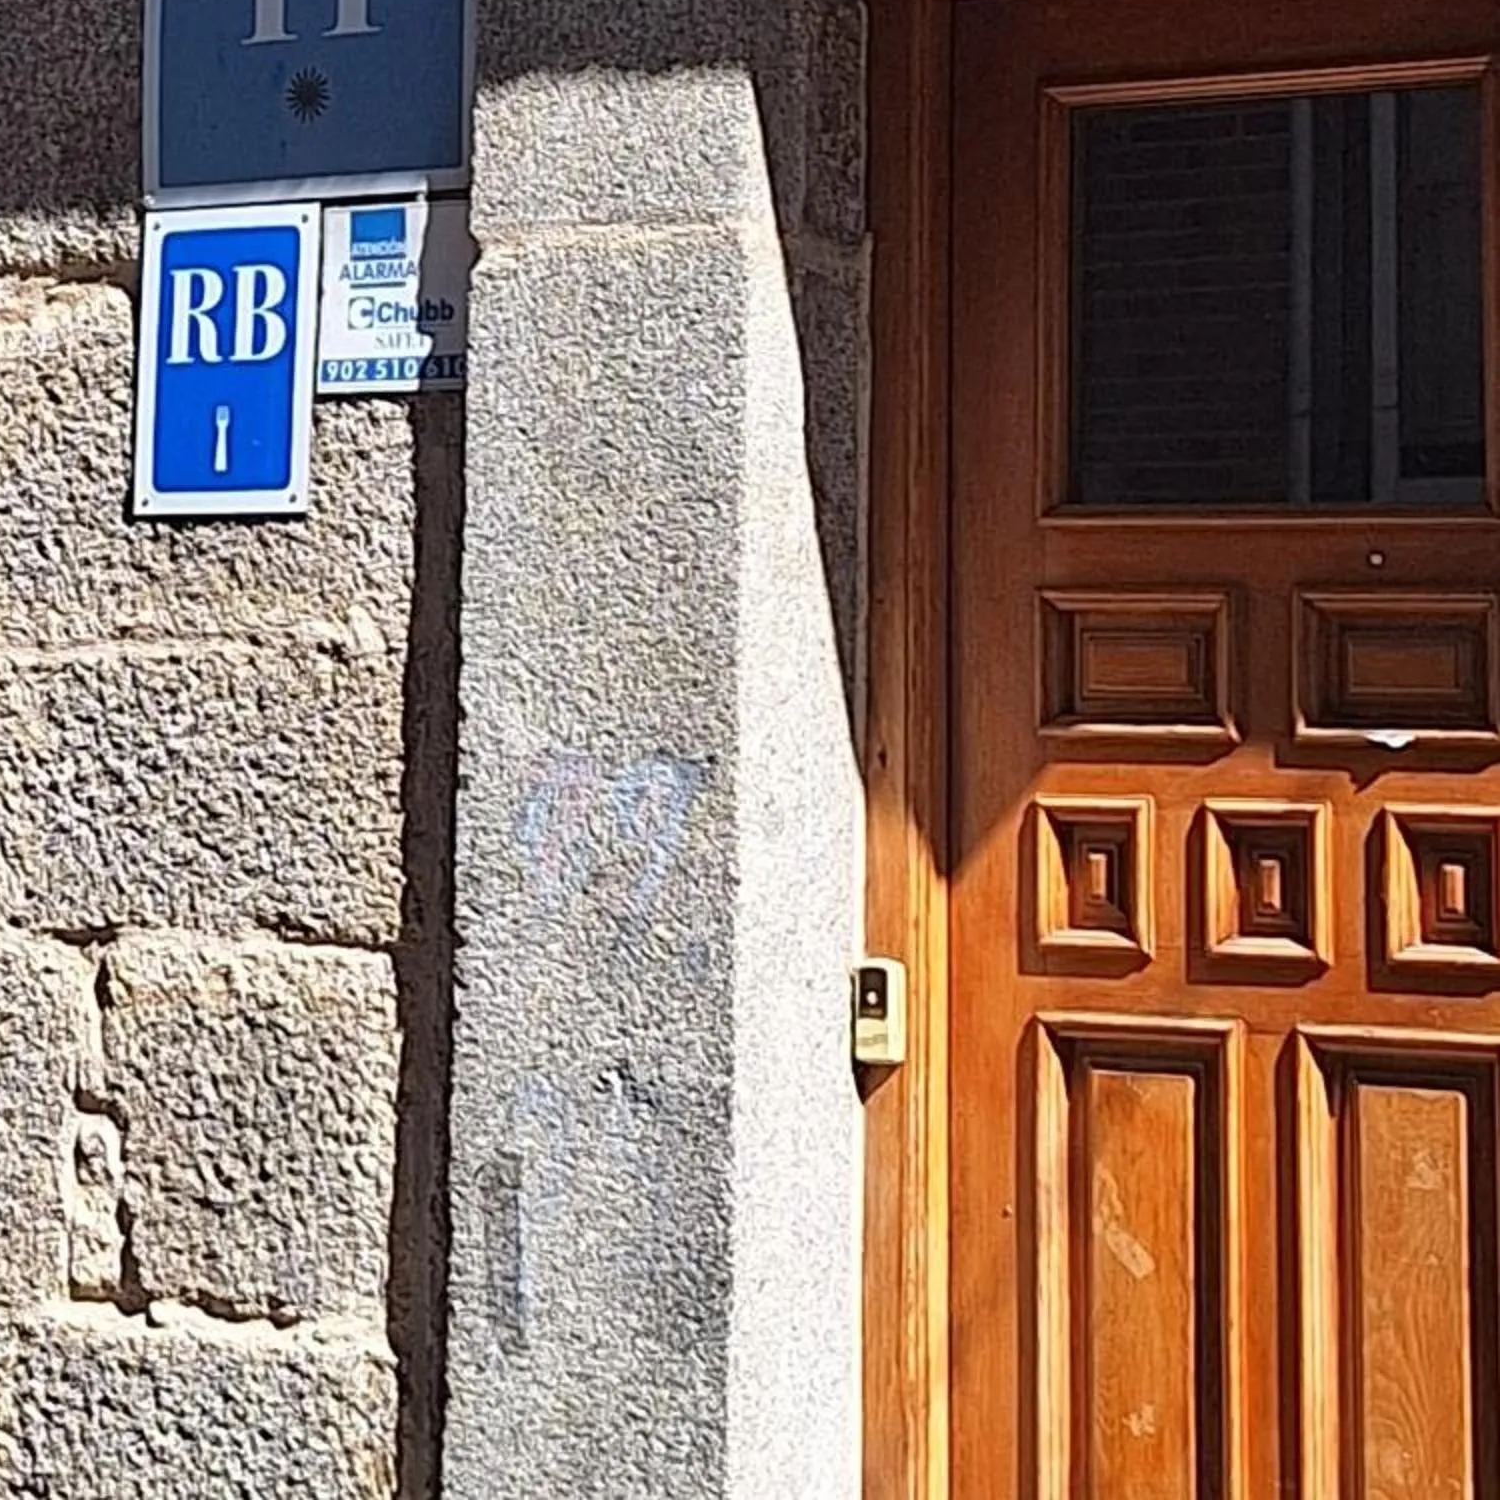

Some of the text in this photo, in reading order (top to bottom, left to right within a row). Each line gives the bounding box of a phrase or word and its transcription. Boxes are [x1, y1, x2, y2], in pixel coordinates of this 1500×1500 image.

[338, 260, 418, 281] ALARMA
[166, 264, 288, 365] RB
[377, 298, 454, 323] Chubb
[326, 360, 367, 380] 902
[375, 357, 418, 378] 510
